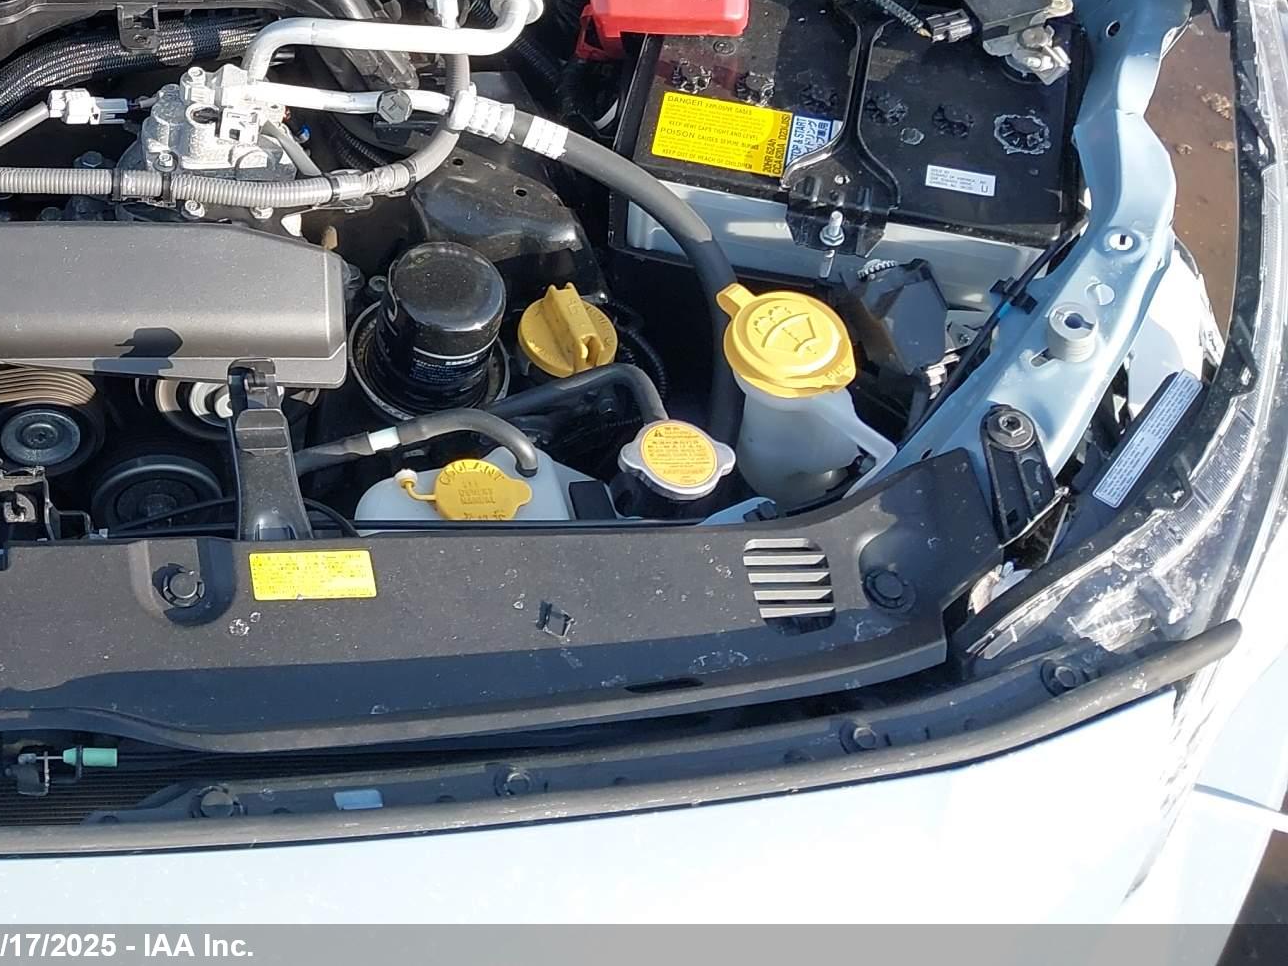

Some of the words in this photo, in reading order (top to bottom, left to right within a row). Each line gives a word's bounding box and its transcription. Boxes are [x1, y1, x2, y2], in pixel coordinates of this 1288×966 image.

[667, 95, 703, 107] DANGER
[661, 127, 695, 138] POISON
[794, 118, 807, 138] START
[773, 160, 782, 174] CCA
